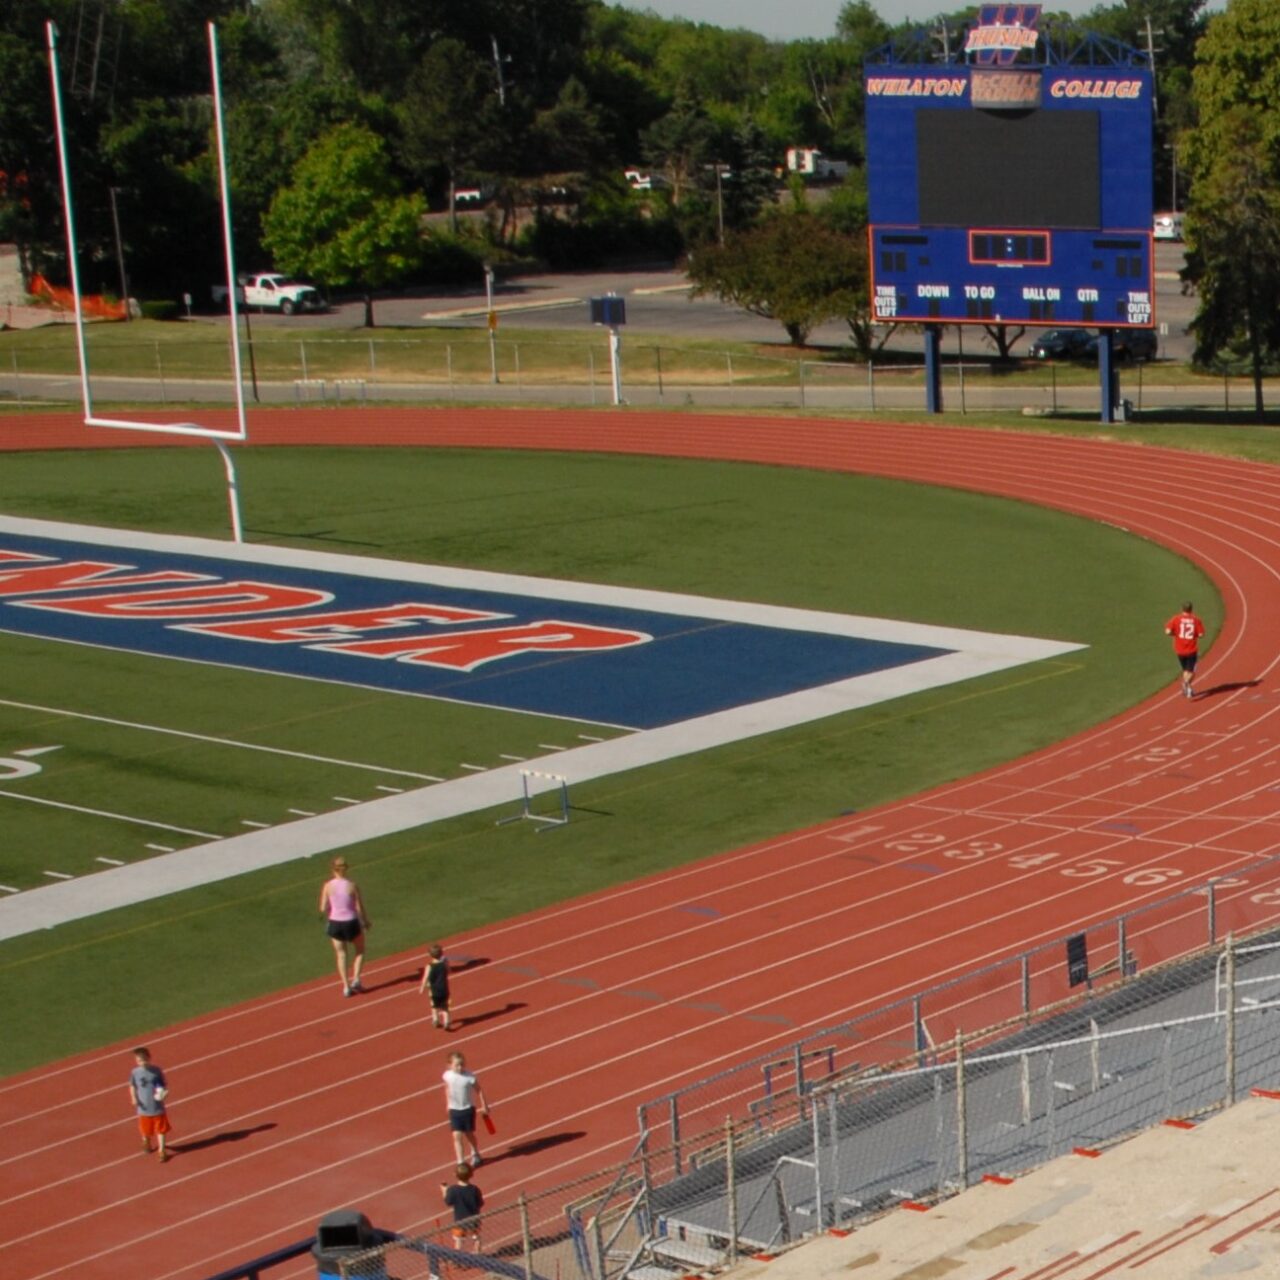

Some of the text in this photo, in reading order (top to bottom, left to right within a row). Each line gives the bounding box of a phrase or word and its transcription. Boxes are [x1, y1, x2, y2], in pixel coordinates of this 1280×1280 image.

[867, 78, 1142, 98] WHEATON COLLEGE
[876, 286, 896, 296] TIME
[917, 285, 950, 298] DOWN
[964, 286, 995, 299] TO GO
[1022, 287, 1060, 300] BALL ON
[1077, 288, 1099, 302] QTR
[1128, 292, 1149, 302] TIME
[874, 296, 897, 306] OUTS
[877, 306, 896, 317] LEFT
[1127, 303, 1151, 313] OUTS
[1128, 313, 1149, 323] LEFT
[0, 549, 654, 672] NDER
[1179, 623, 1194, 640] 12
[826, 825, 885, 843] 1
[884, 832, 946, 852] 2
[943, 841, 1003, 860] 3
[1007, 852, 1061, 869] 4
[1060, 859, 1125, 878] 5
[1122, 867, 1184, 886] 6
